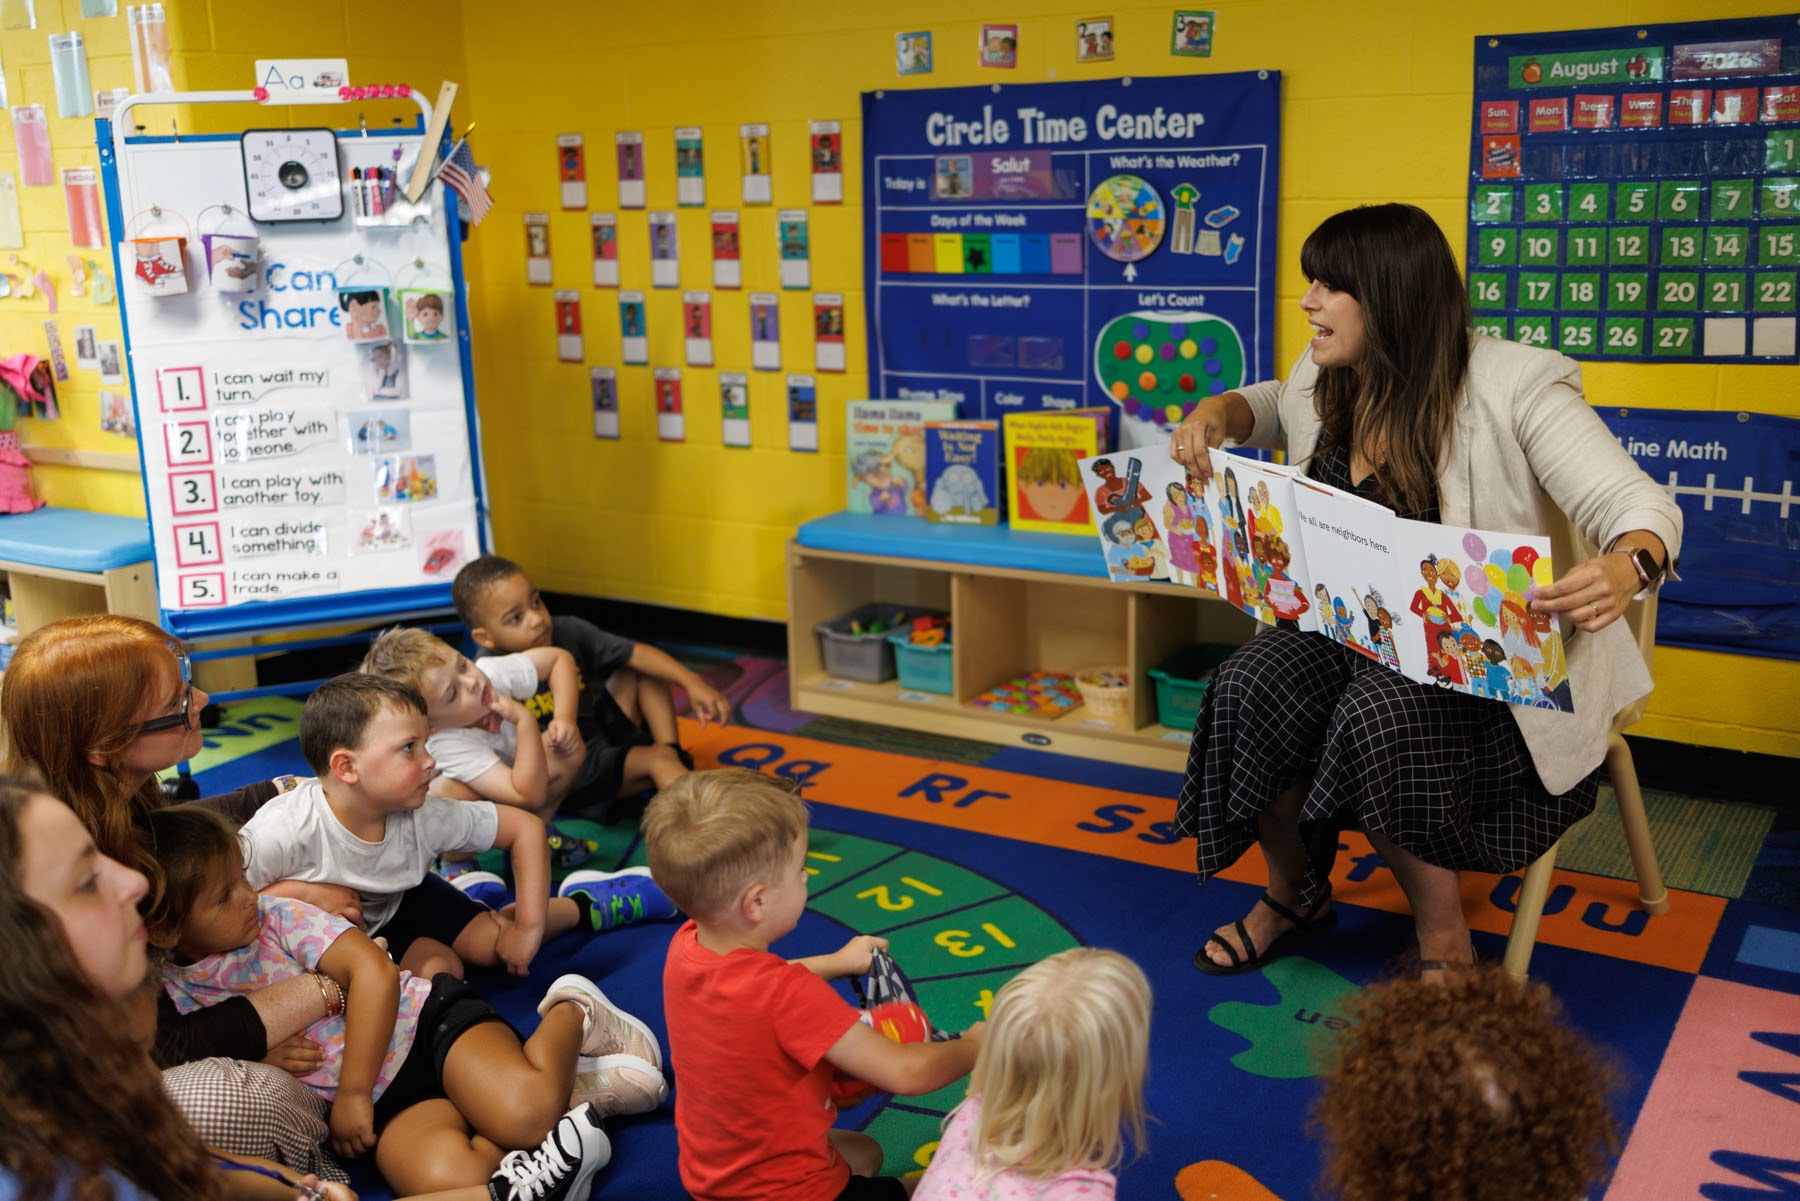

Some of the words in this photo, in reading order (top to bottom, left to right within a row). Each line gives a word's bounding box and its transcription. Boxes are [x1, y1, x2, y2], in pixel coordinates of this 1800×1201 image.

[263, 64, 305, 90] Aa
[1550, 58, 1619, 80] August
[1487, 107, 1509, 117] Sun.
[1535, 106, 1562, 116] Mon.
[1629, 99, 1656, 109] Wed.
[926, 105, 1010, 146] Circle
[1017, 107, 1088, 144] Time
[1095, 104, 1205, 141] Center
[1784, 139, 1794, 160] 1
[991, 157, 1031, 174] Salut
[1110, 155, 1153, 169] What's
[1155, 155, 1175, 169] the
[1177, 152, 1240, 168] Weather?
[915, 176, 926, 190] is
[1487, 195, 1501, 214] 2
[1536, 194, 1551, 213] 3
[1580, 193, 1597, 213] 4
[1629, 192, 1644, 212] 5
[1671, 191, 1687, 211] 6
[1727, 190, 1741, 210] 7
[1774, 189, 1791, 209] 8
[930, 213, 958, 230] Days
[973, 213, 994, 227] the
[994, 213, 1026, 227] Week
[1491, 238, 1506, 257] 9
[1527, 238, 1552, 258] 10
[1574, 238, 1597, 257] 11
[1616, 236, 1640, 257] 12
[1670, 237, 1695, 257] 13
[1714, 236, 1740, 257] 14
[1768, 235, 1794, 256] 15
[265, 263, 337, 293] Can
[1138, 291, 1166, 307] Let's
[1167, 292, 1205, 307] Count
[1477, 282, 1501, 301] 16
[1527, 282, 1551, 301] 17
[1569, 282, 1594, 301] 18
[1616, 282, 1641, 301] 19
[1664, 282, 1695, 302] 20
[1712, 282, 1739, 302] 21
[1760, 282, 1791, 302] 22
[240, 300, 341, 331] Share
[1519, 325, 1548, 345] 24
[1563, 327, 1592, 346] 25
[1608, 327, 1638, 347] 26
[1659, 327, 1688, 347] 27
[214, 372, 219, 385] I
[224, 373, 254, 385] can
[260, 370, 294, 384] wait
[300, 370, 325, 384] my
[994, 391, 1024, 405] Color
[259, 410, 295, 427] play
[294, 421, 328, 436] with
[180, 430, 202, 455] 2.
[1617, 436, 1661, 458] ine
[1666, 440, 1727, 461] Math
[222, 477, 226, 489] I
[231, 478, 261, 489] can
[266, 475, 302, 489] play
[309, 472, 343, 486] with
[183, 480, 206, 503] 3.
[223, 490, 289, 505] another
[240, 527, 270, 538] can
[274, 521, 324, 536] divide
[1308, 516, 1318, 527] all
[1318, 521, 1331, 532] are
[1331, 526, 1369, 546] neighbors
[1369, 538, 1390, 554] here.
[189, 530, 213, 555] 4.
[242, 571, 271, 581] can
[276, 570, 320, 581] make
[326, 571, 337, 580] a
[192, 580, 215, 598] 5.
[717, 743, 832, 788] Qq
[897, 773, 1011, 808] Rr
[1075, 804, 1183, 845] Ss
[1489, 873, 1650, 937] Uu
[856, 876, 943, 911] 12
[934, 922, 1017, 958] 13
